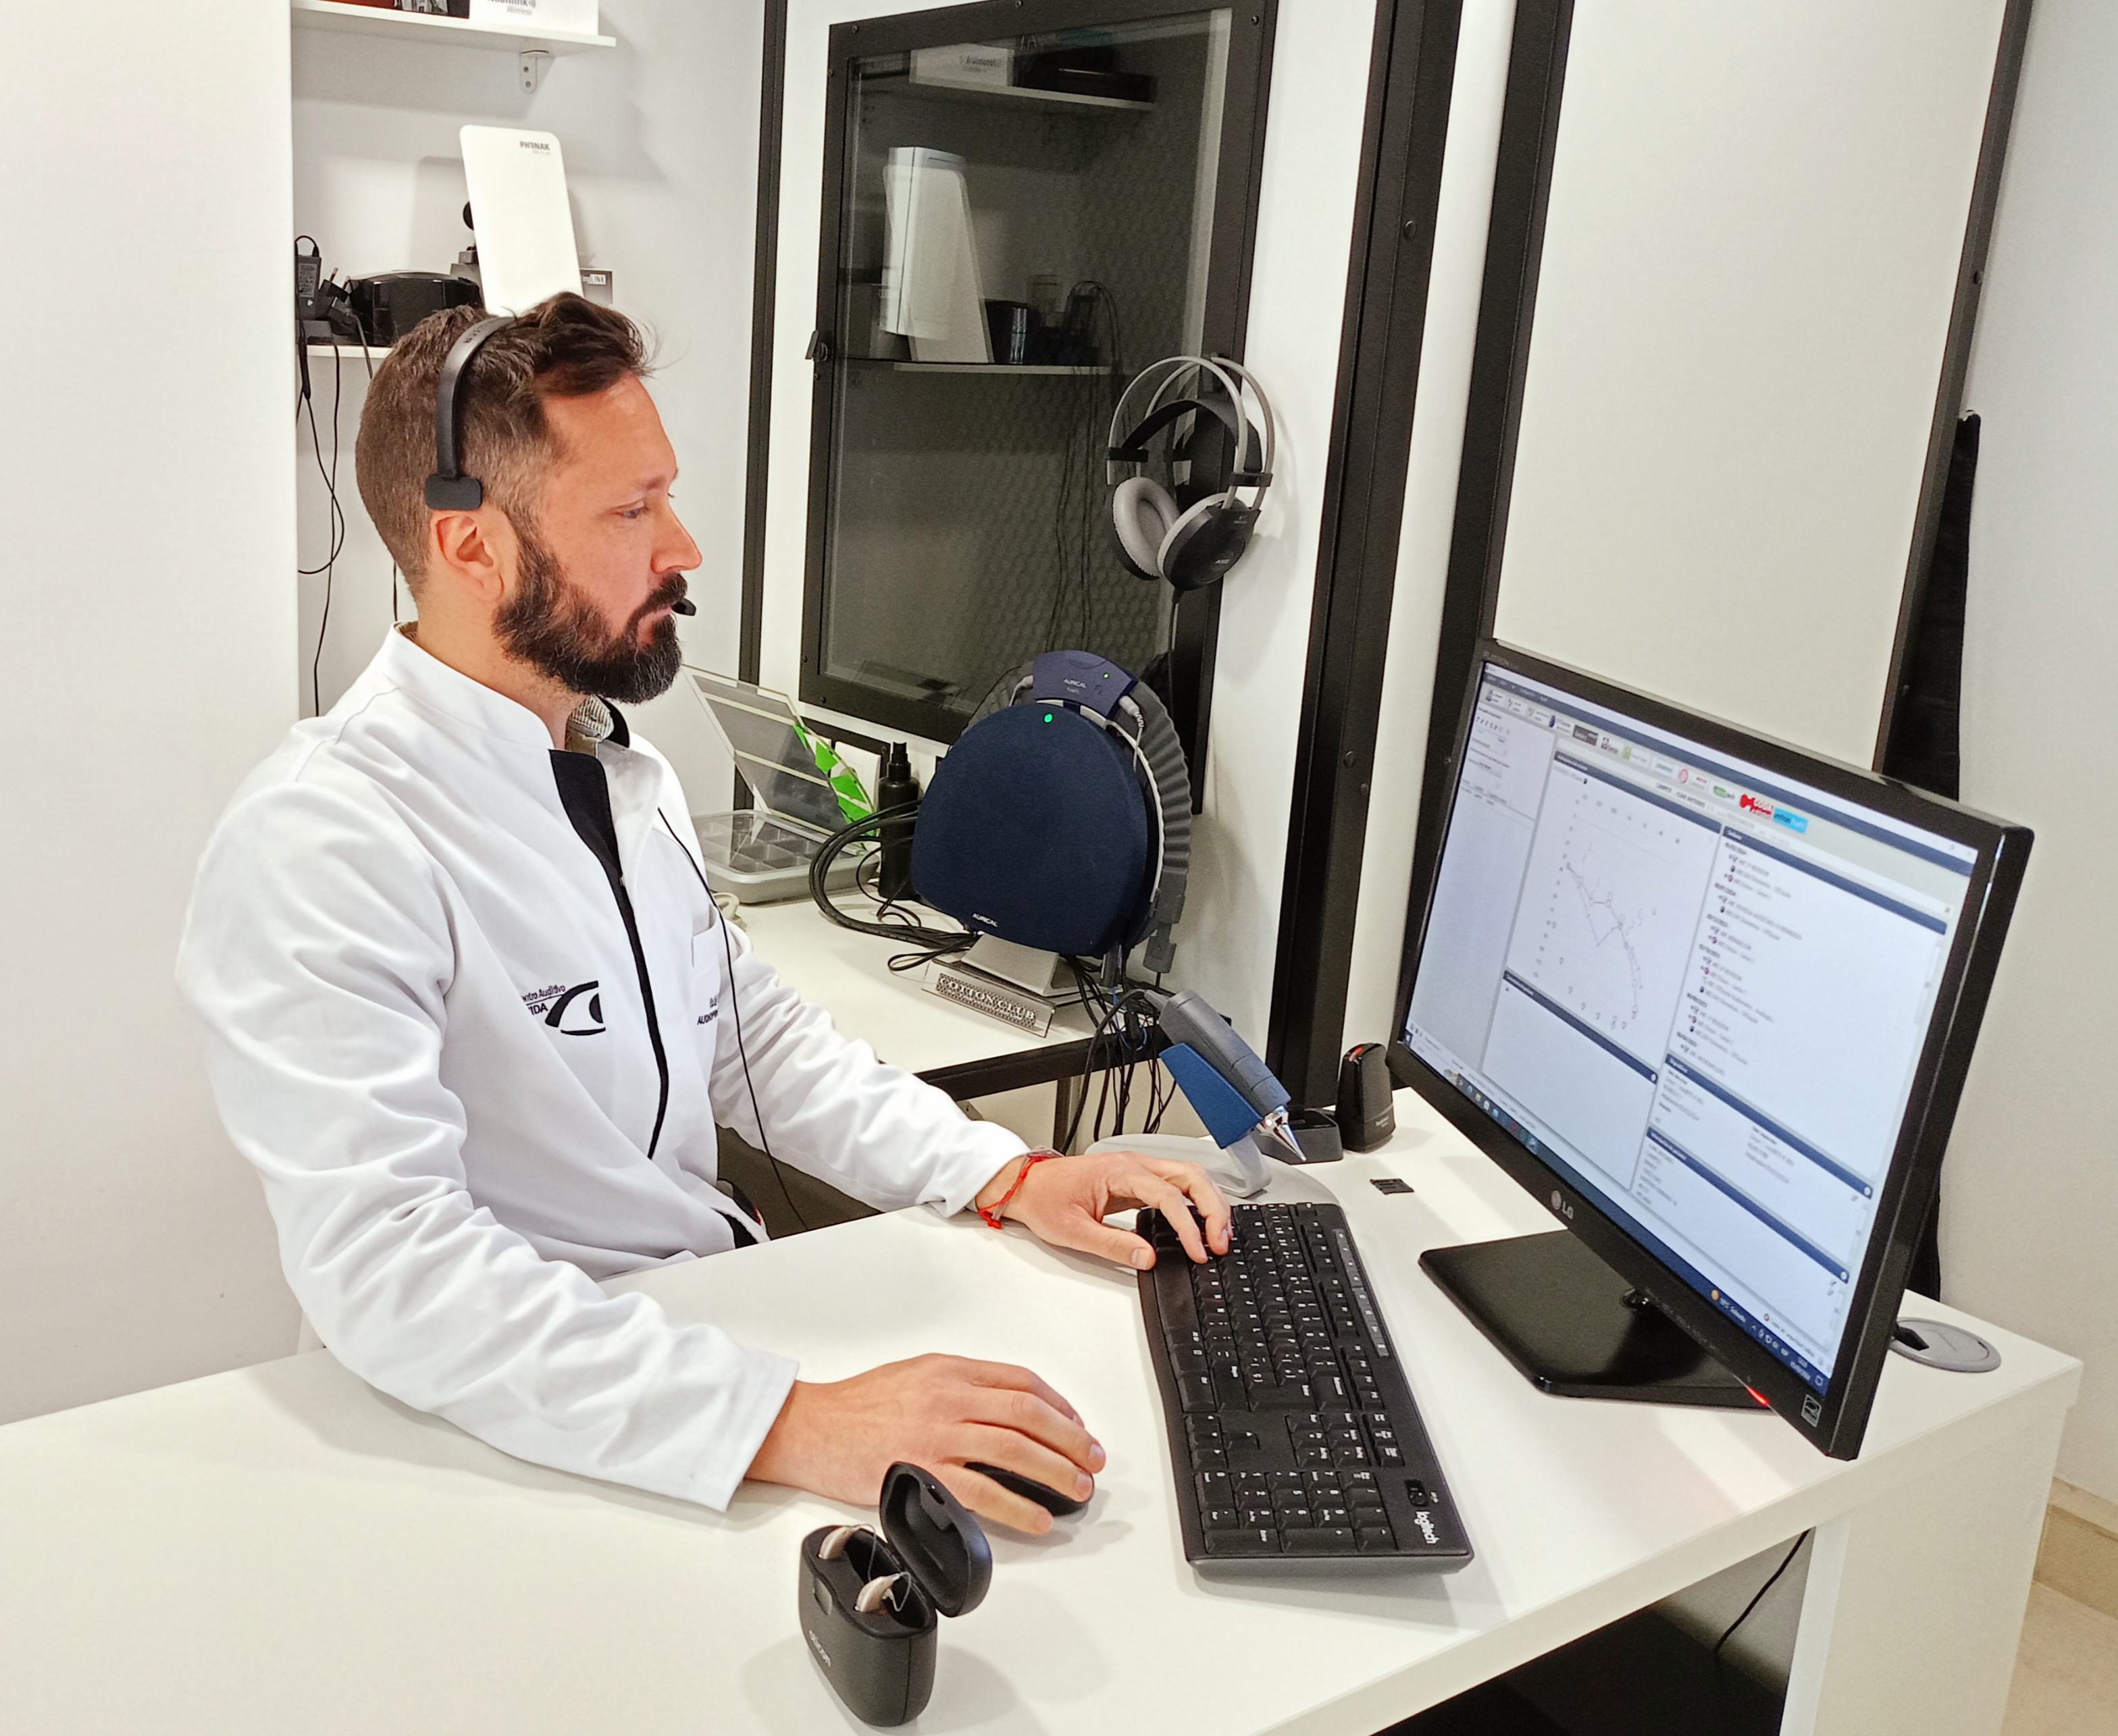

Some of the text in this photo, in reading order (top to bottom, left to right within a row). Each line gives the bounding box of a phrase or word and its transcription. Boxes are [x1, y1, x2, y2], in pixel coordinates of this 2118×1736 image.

[519, 141, 550, 150] PHONAK
[591, 275, 604, 283] LINK
[1063, 679, 1087, 688] AURICAL
[972, 913, 998, 927] AURICAL
[539, 985, 566, 998] Auditivo
[939, 977, 994, 1006] COTTON
[998, 999, 1035, 1020] CLUB
[527, 1003, 548, 1015] IDA
[1562, 1201, 1574, 1220] LG
[1414, 1510, 1440, 1545] logitech
